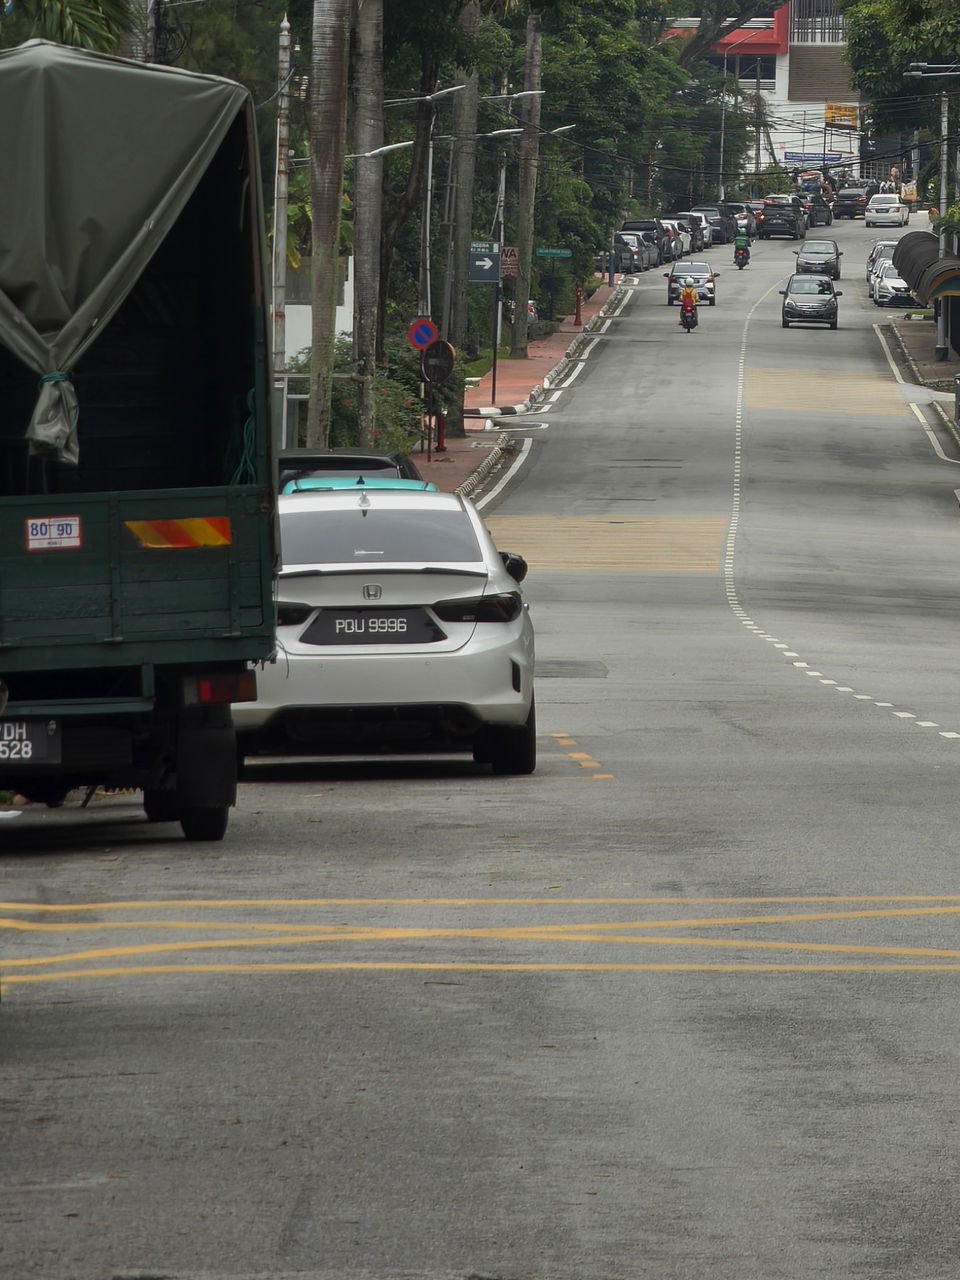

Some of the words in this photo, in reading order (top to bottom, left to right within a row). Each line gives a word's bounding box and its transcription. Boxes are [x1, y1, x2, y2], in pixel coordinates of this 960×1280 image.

[30, 522, 48, 537] 80
[57, 523, 73, 536] 90
[368, 618, 407, 632] 9996
[0, 722, 27, 740] DH
